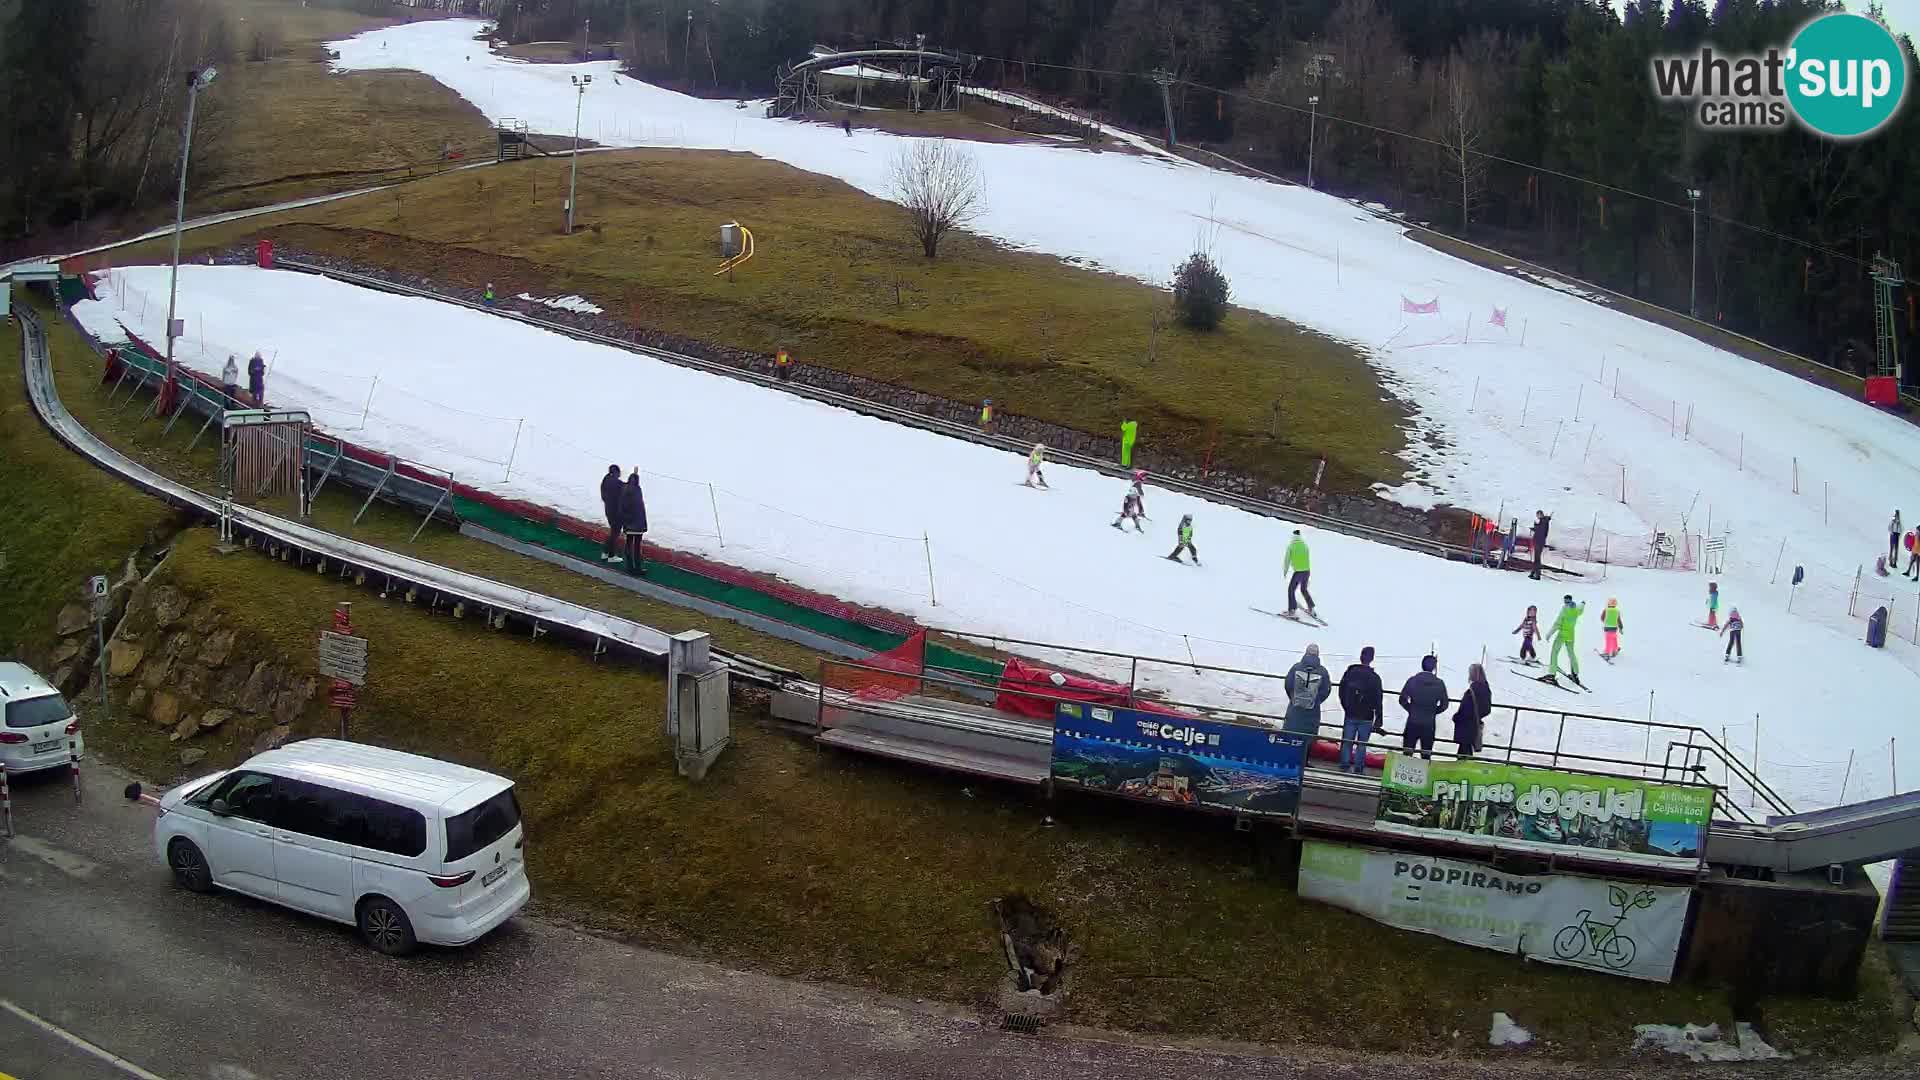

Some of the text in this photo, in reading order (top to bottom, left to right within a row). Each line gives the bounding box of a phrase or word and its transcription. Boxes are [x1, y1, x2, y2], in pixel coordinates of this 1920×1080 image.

[1160, 724, 1206, 746] Celje
[1432, 779, 1468, 802] Pri
[1472, 783, 1515, 803] nas
[1516, 784, 1643, 822] dogaja!
[1394, 861, 1542, 894] PODPIRAMO
